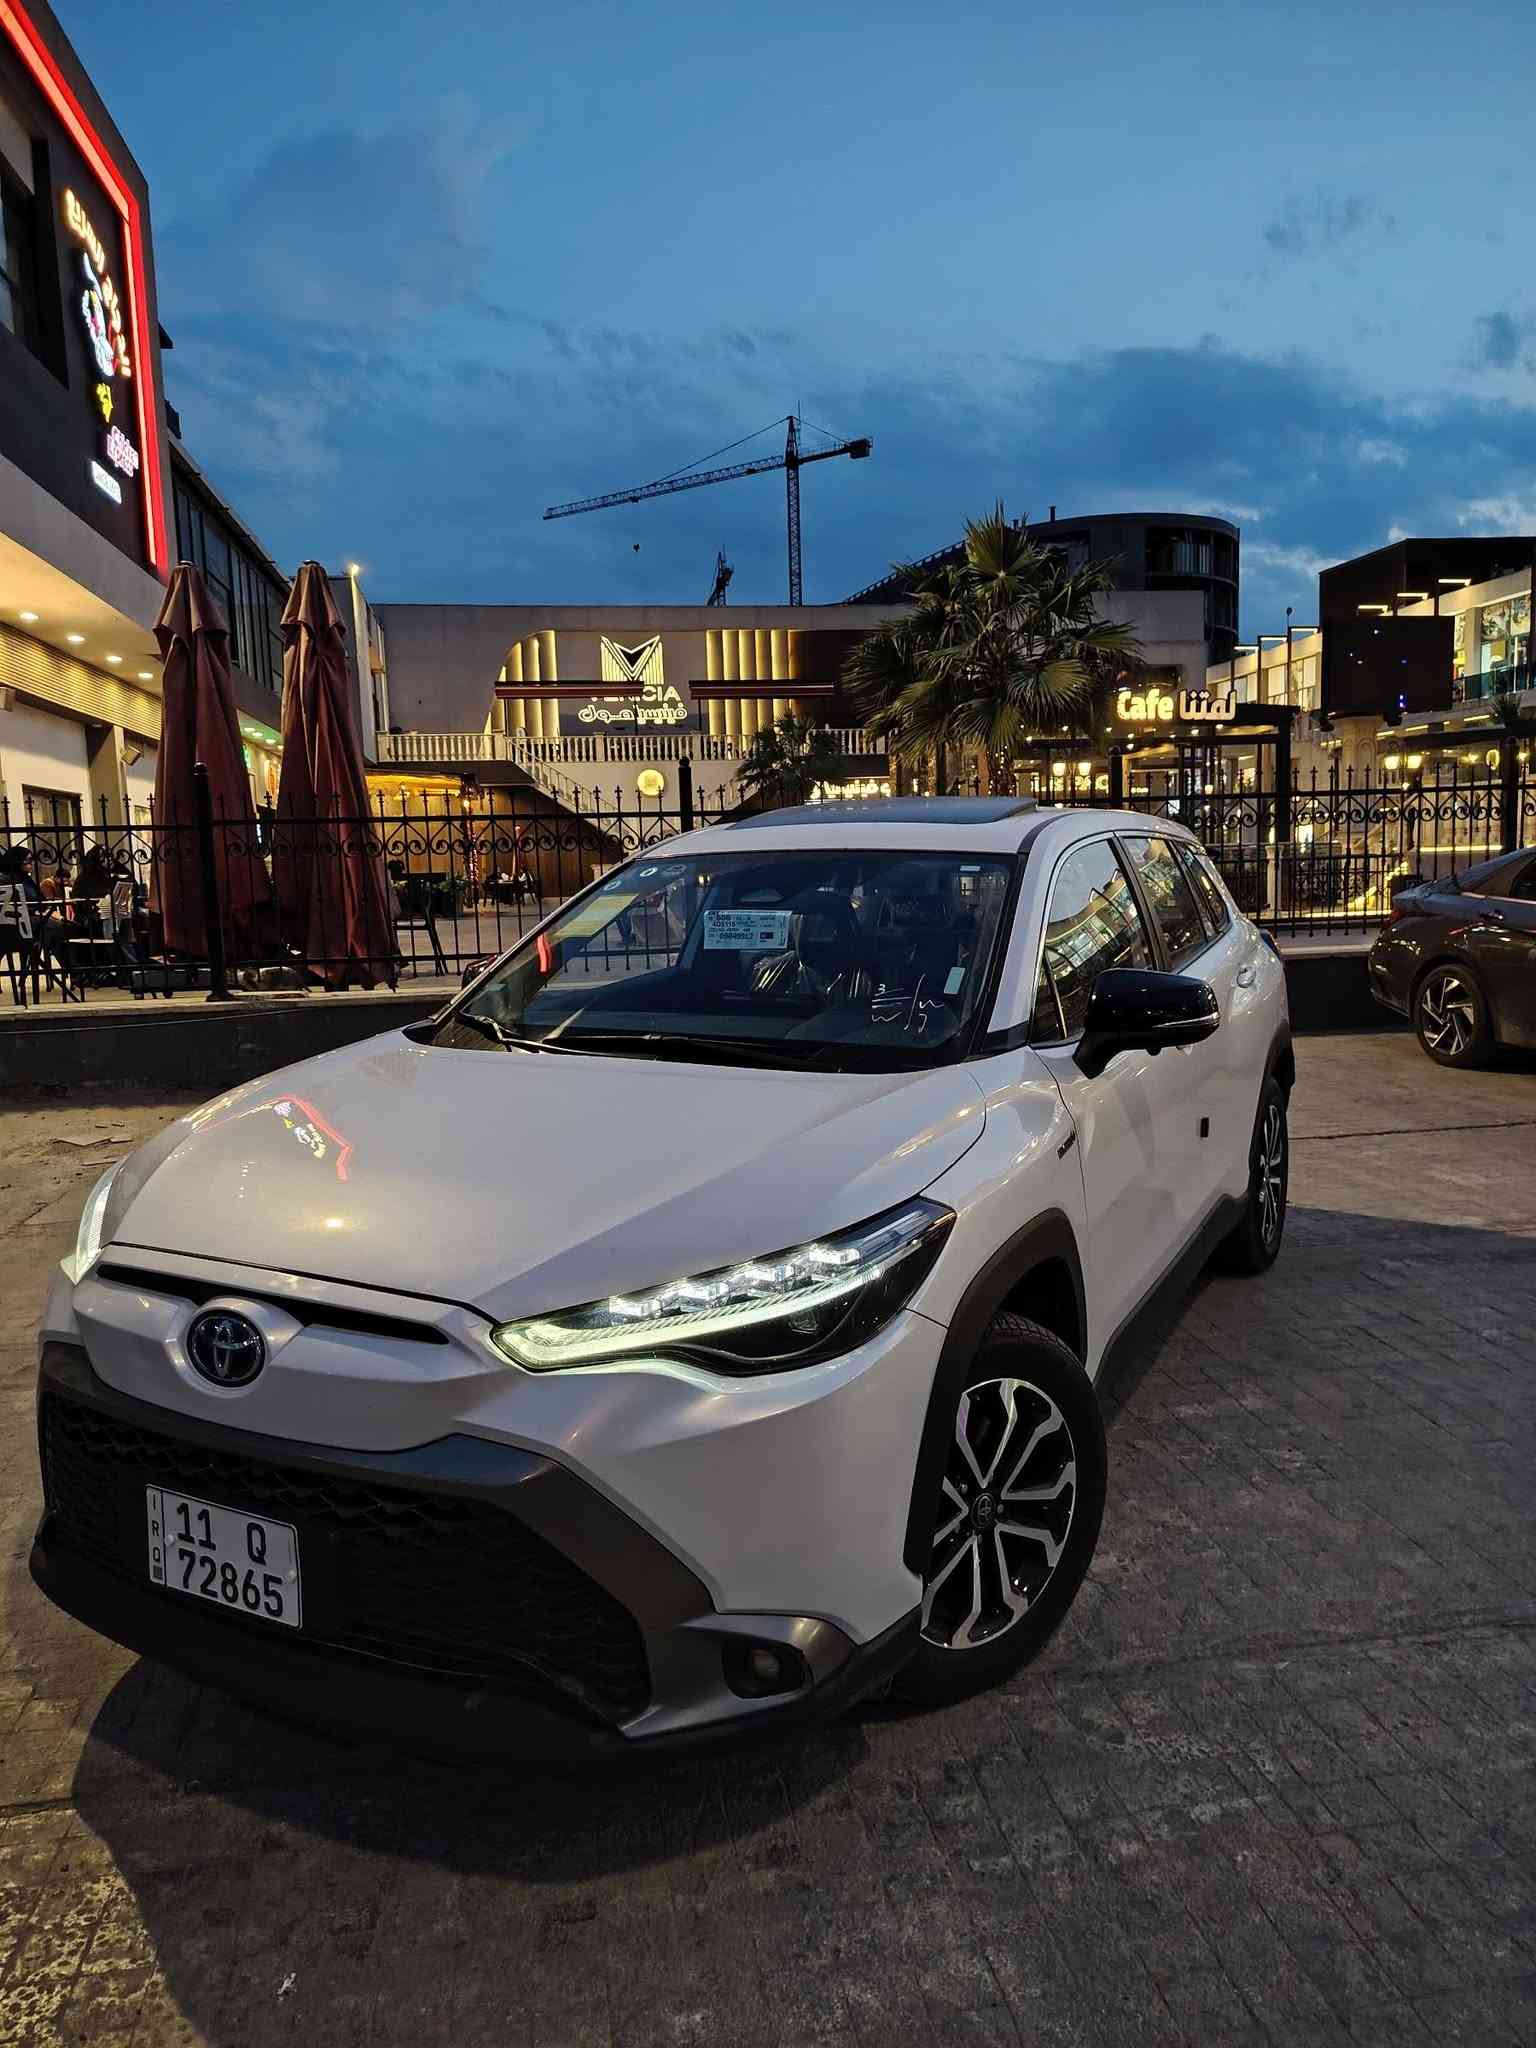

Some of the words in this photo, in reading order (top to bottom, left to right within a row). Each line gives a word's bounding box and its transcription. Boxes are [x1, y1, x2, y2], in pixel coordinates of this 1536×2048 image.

[1117, 688, 1174, 721] Cafe
[176, 1502, 217, 1551] 11
[246, 1521, 267, 1566] Q
[178, 1547, 284, 1618] 72865
